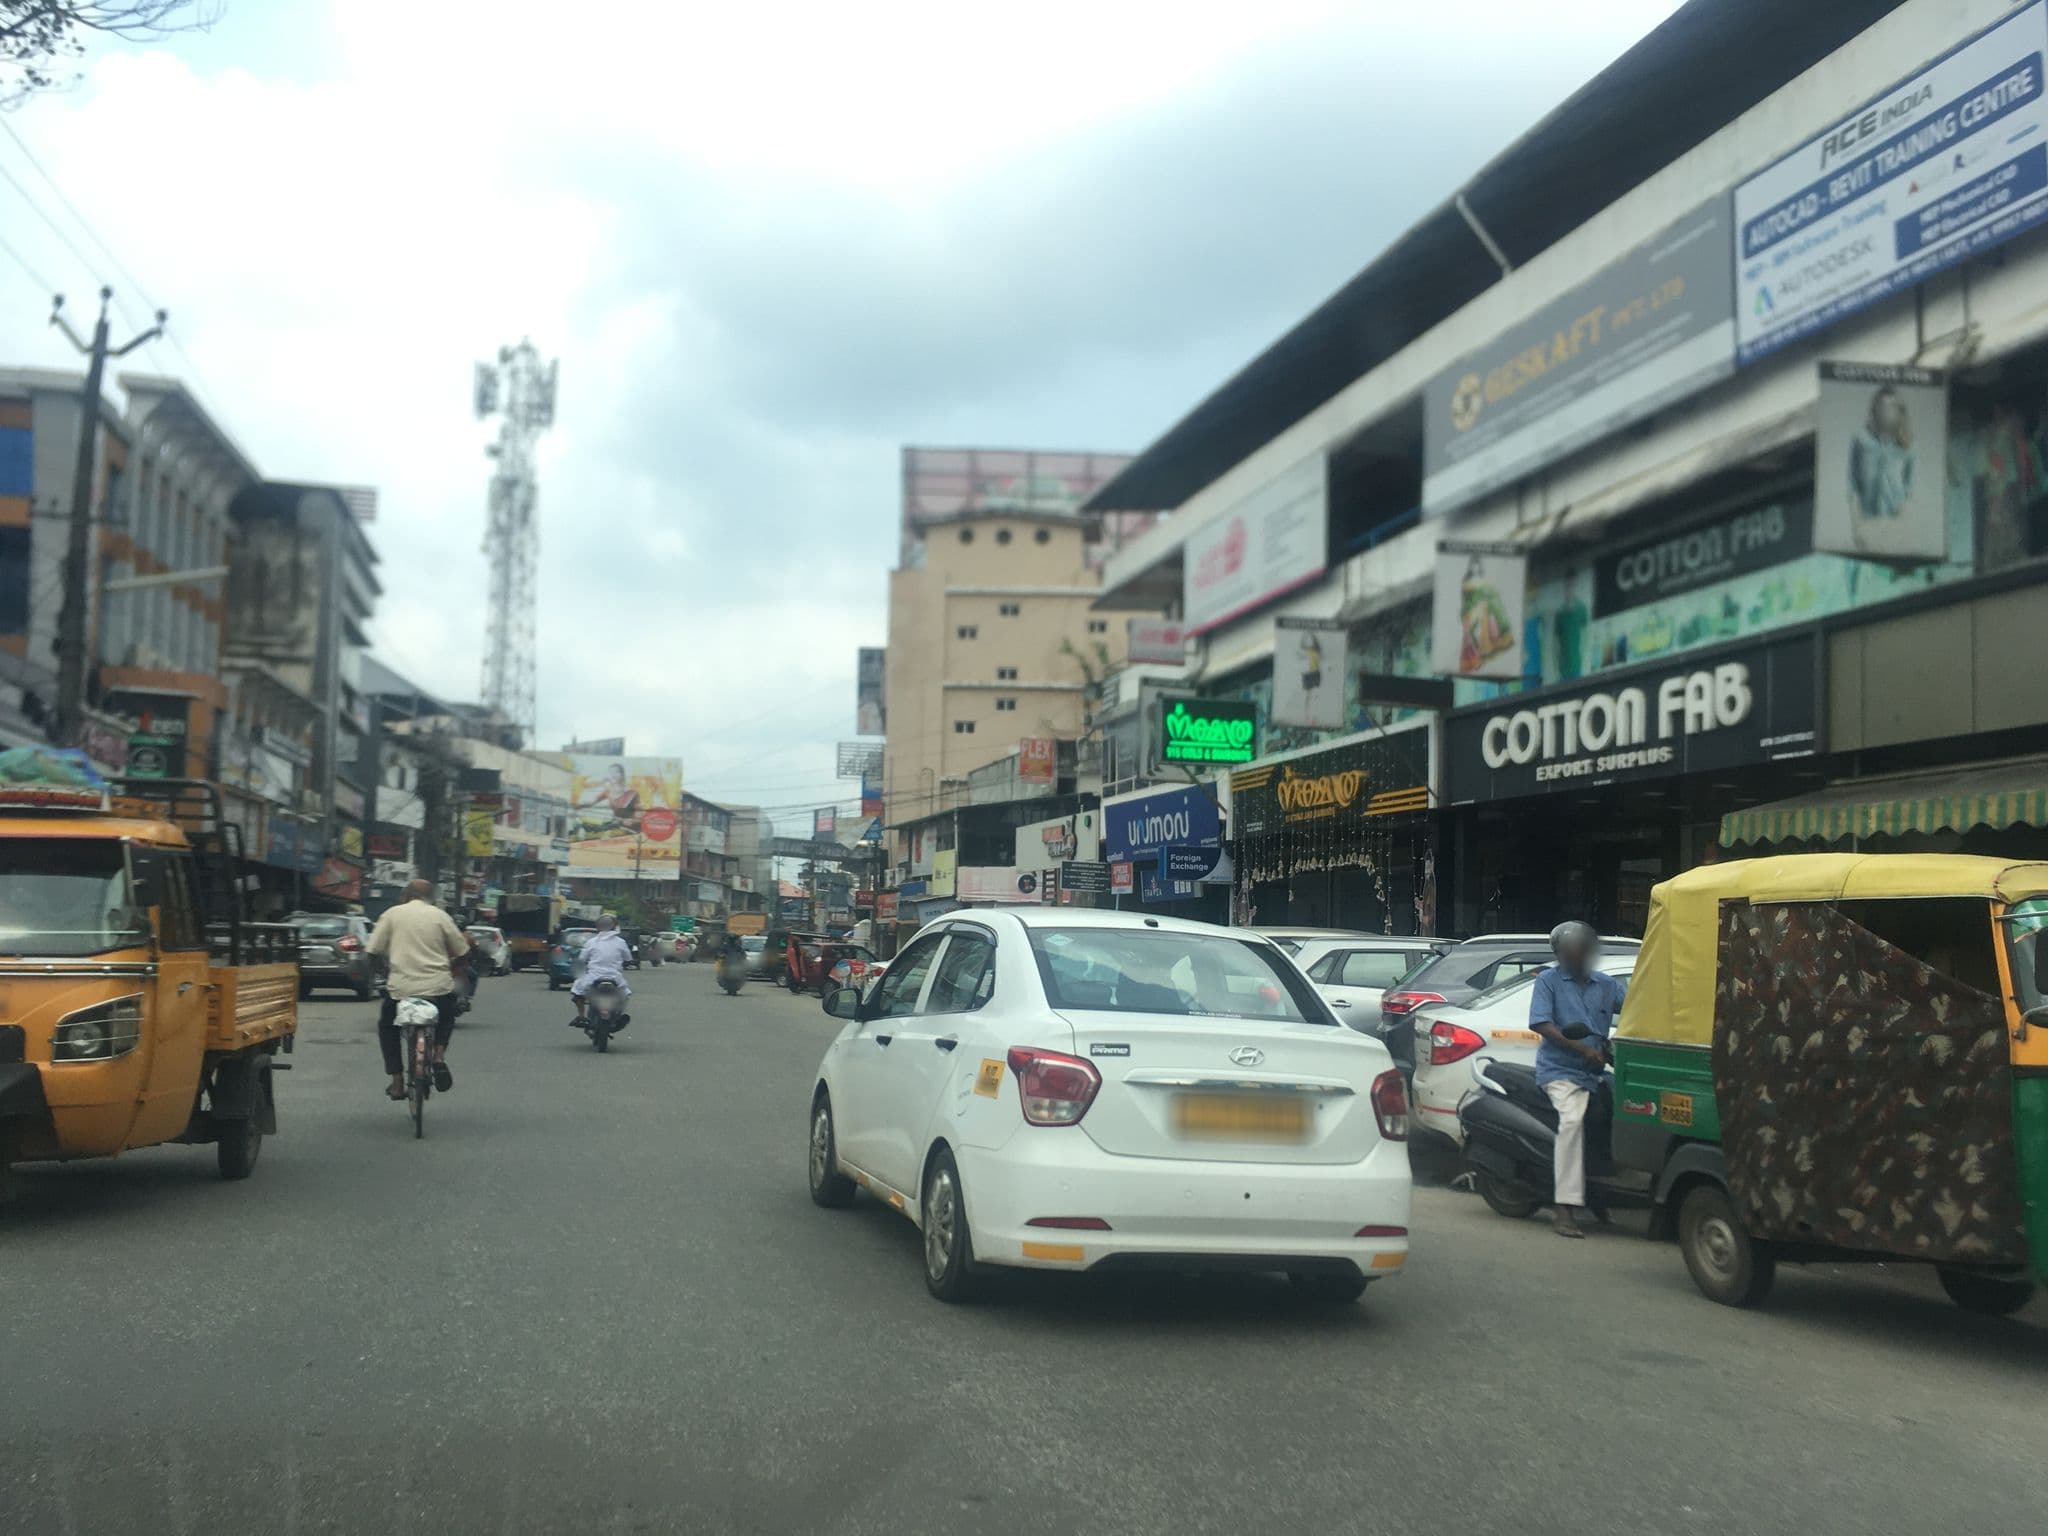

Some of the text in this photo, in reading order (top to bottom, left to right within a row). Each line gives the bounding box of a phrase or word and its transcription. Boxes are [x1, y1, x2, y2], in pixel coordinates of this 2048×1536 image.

[1748, 192, 1820, 249] AUTOCAD
[1829, 162, 1875, 204] REVIT
[1876, 111, 1956, 174] TRAINING
[1959, 65, 2035, 128] CENTRE
[1819, 84, 1933, 170] ACE INDIA
[1616, 527, 1723, 590] COTTON
[1731, 504, 1787, 555] FAB
[1482, 661, 1753, 769] COTTON FAB
[1536, 746, 1673, 782] EXPORT SURPLUS
[1128, 795, 1189, 846] unimoni
[1170, 854, 1202, 863] Foreign
[1170, 862, 1209, 872] Exchange
